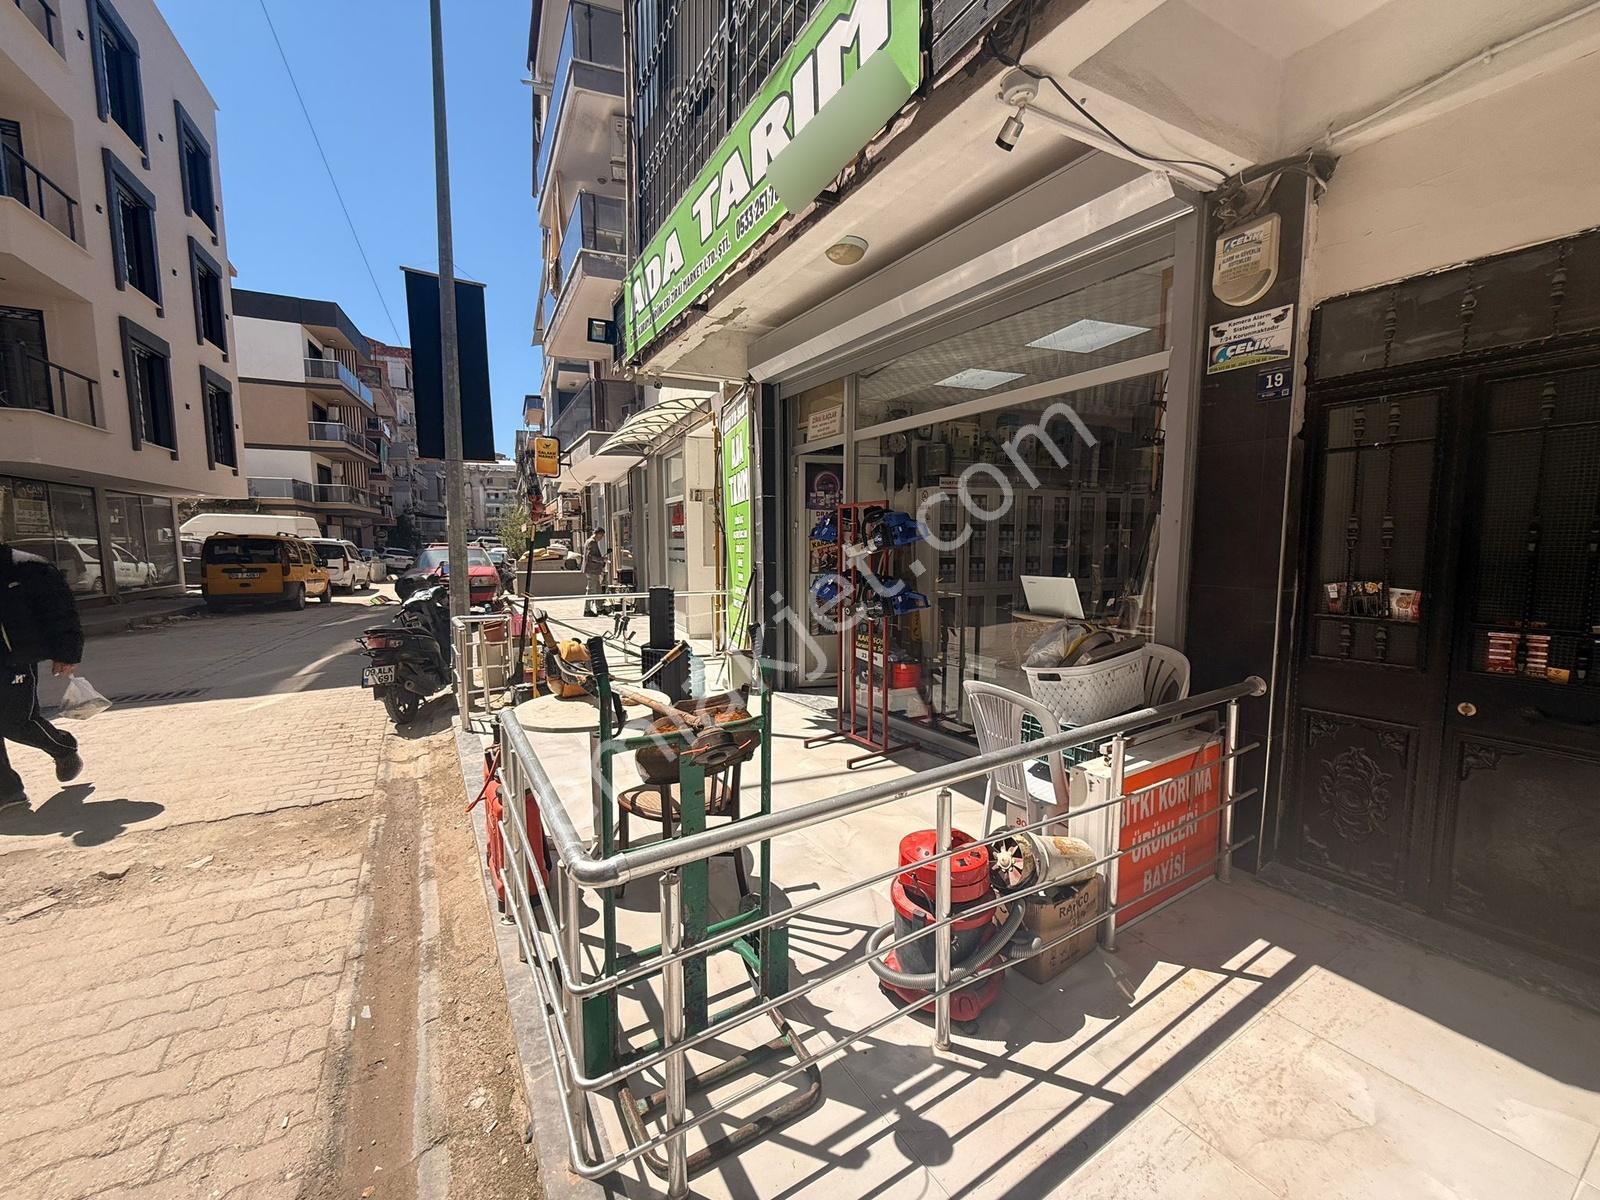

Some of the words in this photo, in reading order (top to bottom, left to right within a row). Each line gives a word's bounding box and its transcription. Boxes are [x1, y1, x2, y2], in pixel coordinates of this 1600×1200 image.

[629, 229, 685, 324] ADA
[691, 0, 891, 247] TARIM
[683, 262, 704, 289] MARKET
[1228, 318, 1251, 328] Kamera
[1252, 312, 1272, 321] Alarm
[1233, 322, 1256, 333] Sistemi
[1257, 320, 1265, 328] ile
[1233, 324, 1280, 340] Korunmaktadır
[1265, 372, 1284, 389] 19
[377, 674, 393, 683] 691
[1143, 845, 1186, 894] BAYİSİ
